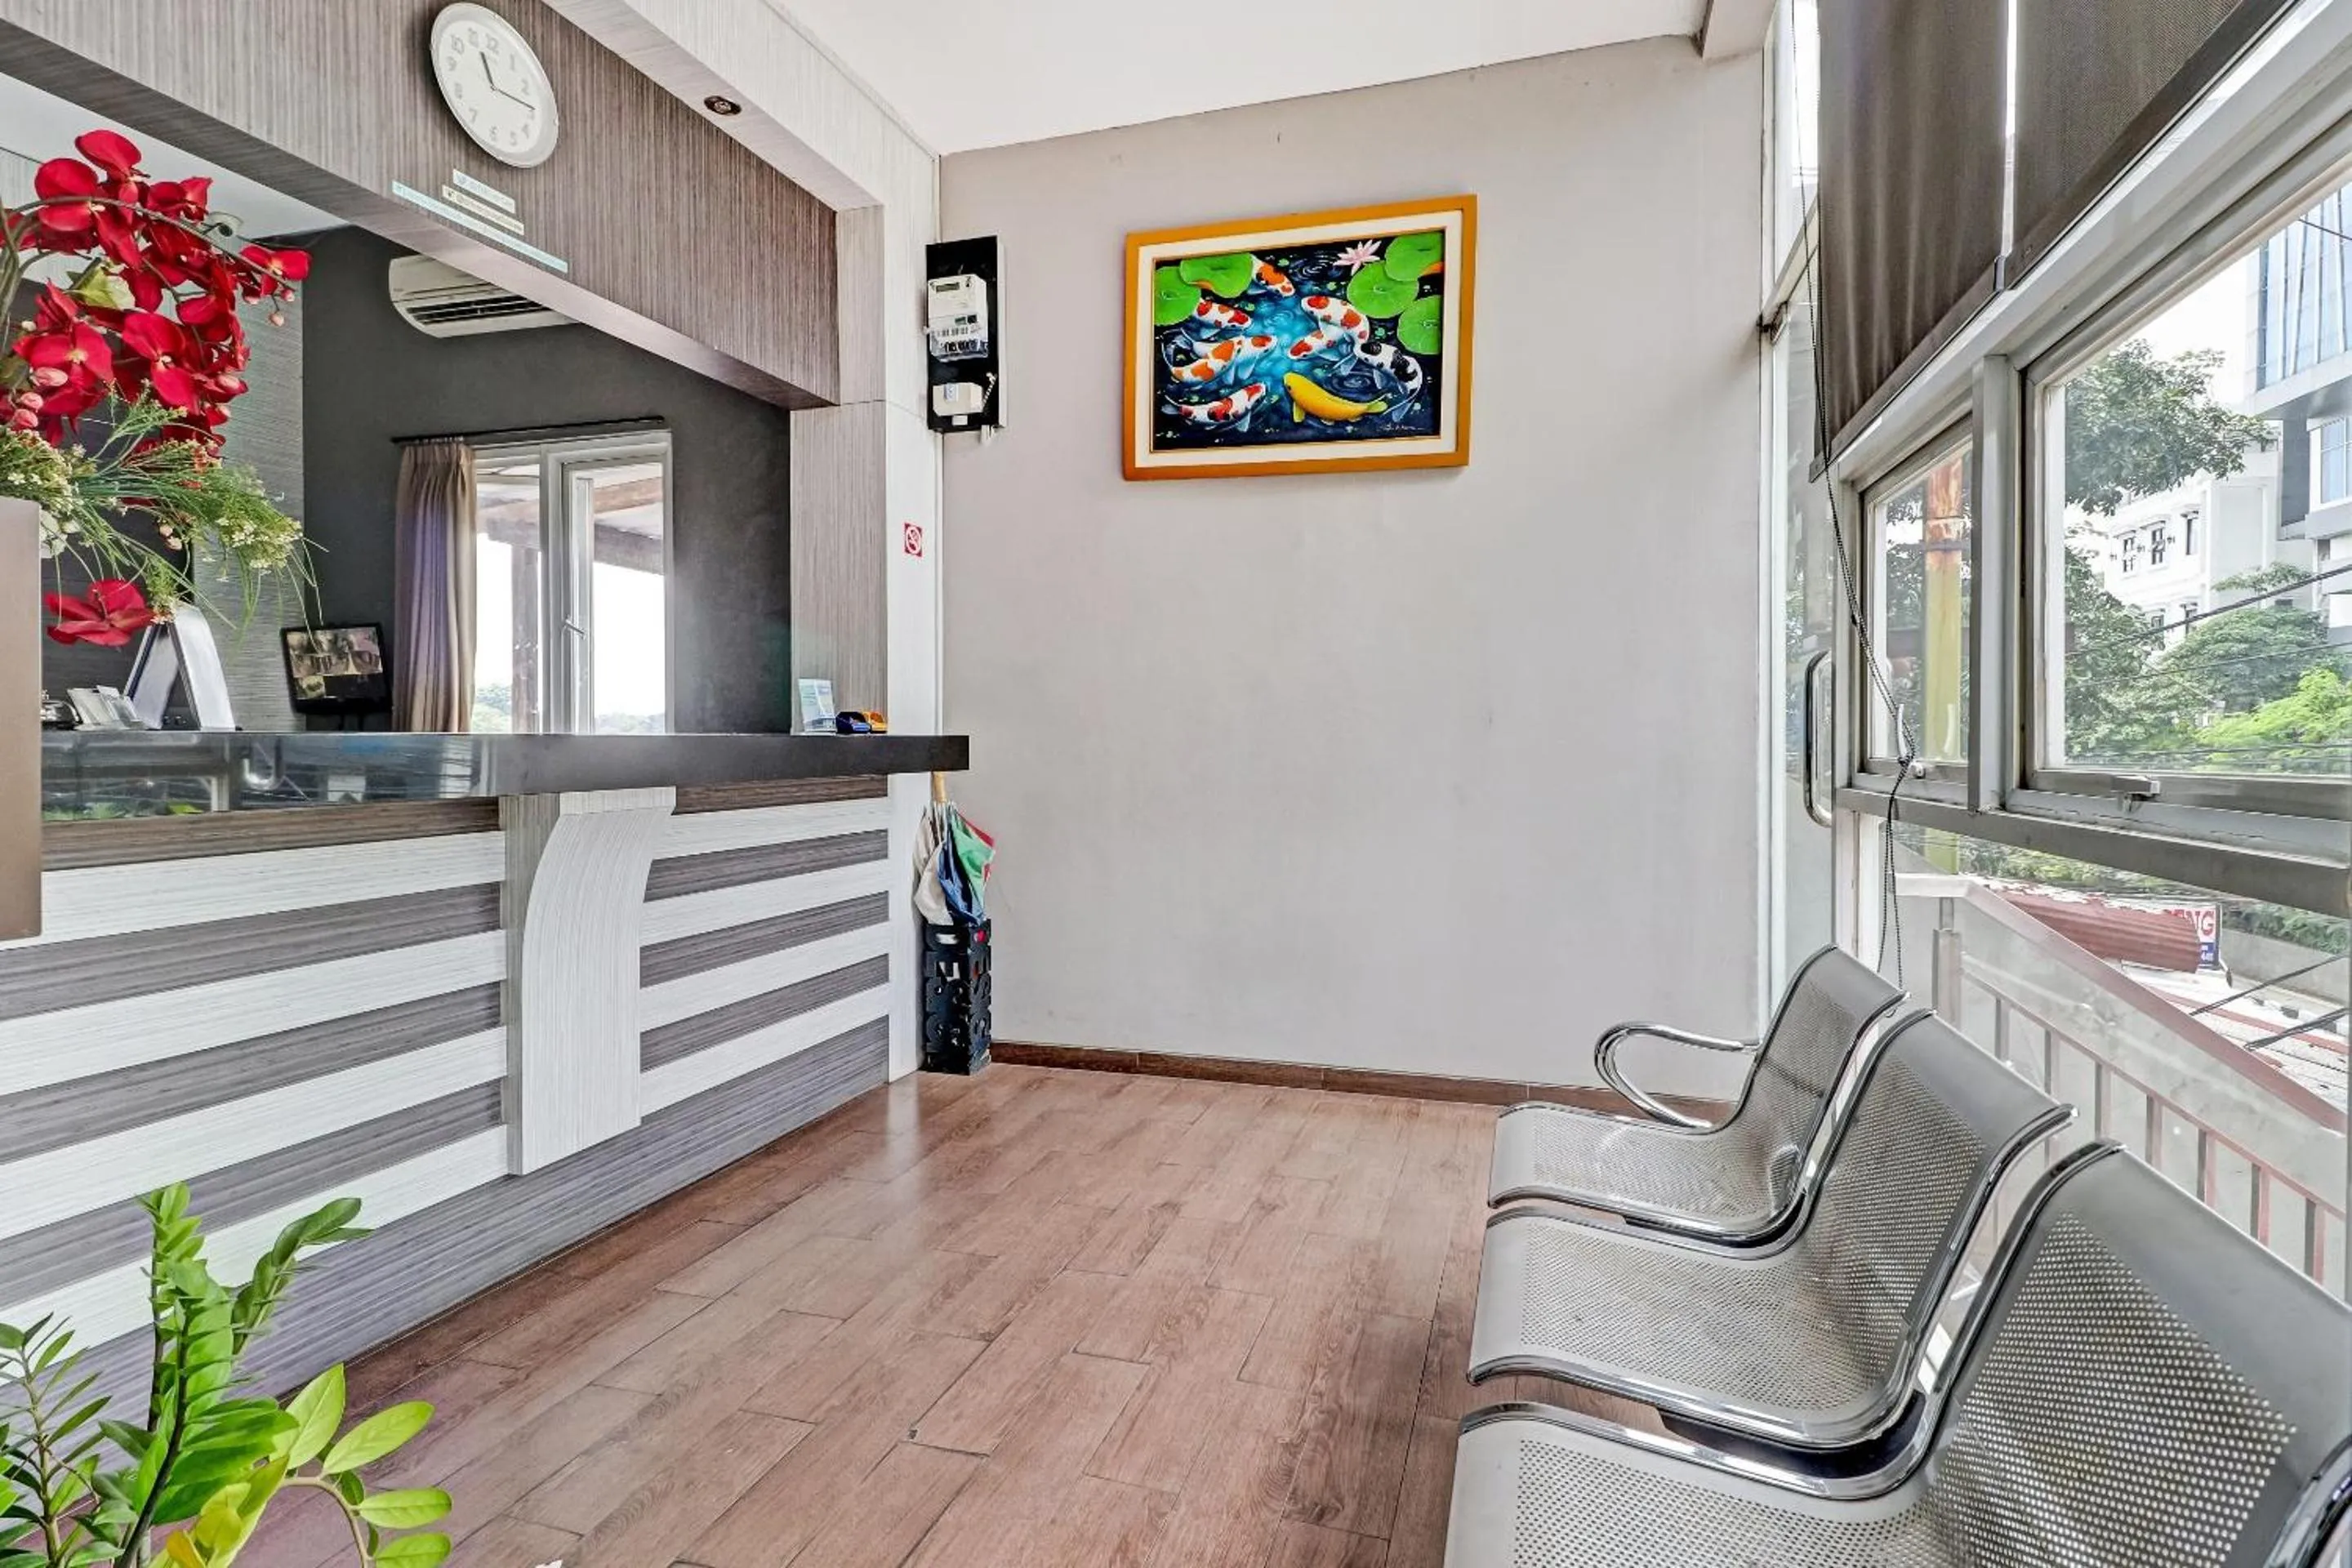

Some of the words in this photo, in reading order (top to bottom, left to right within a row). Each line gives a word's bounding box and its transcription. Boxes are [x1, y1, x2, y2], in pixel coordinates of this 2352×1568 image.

[521, 78, 529, 96] 2
[468, 107, 477, 124] 7
[510, 131, 517, 146] 5
